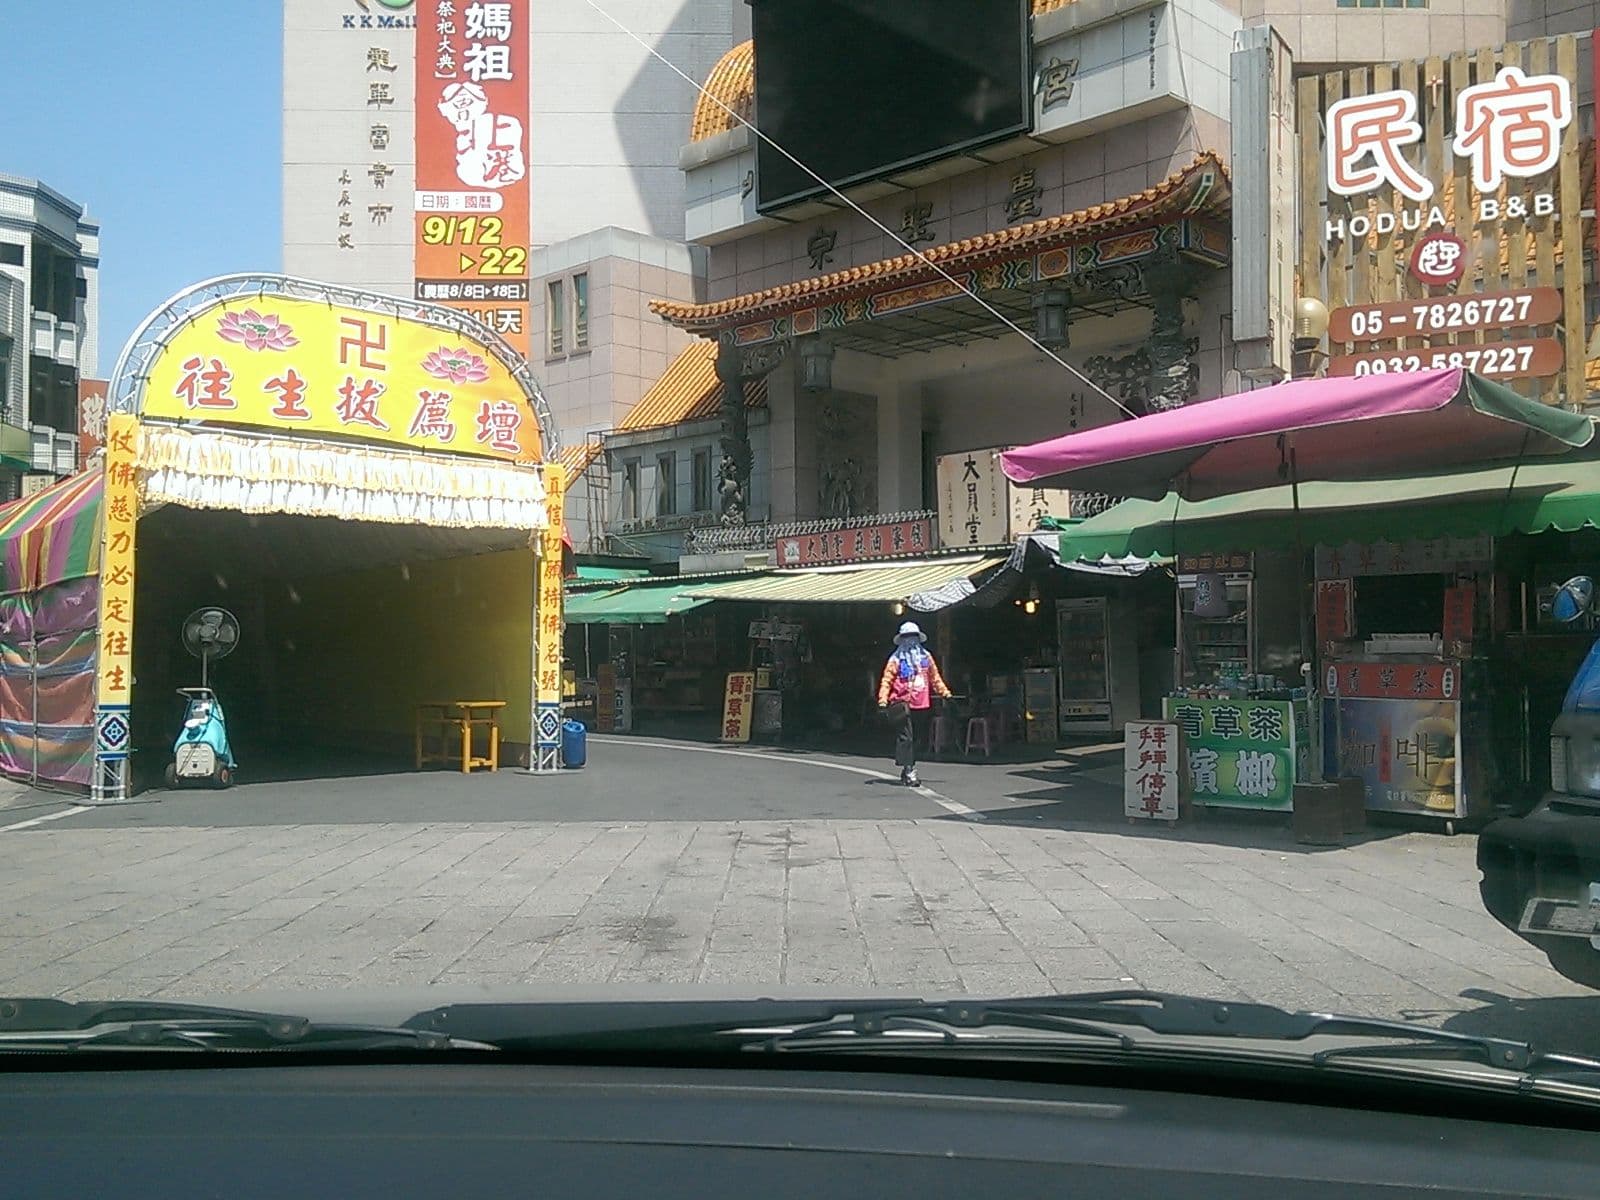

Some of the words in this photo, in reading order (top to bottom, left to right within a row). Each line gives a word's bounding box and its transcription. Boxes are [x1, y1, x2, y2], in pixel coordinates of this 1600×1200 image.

[463, 1, 514, 81] 媽祖
[1041, 57, 1079, 110] 宮
[1326, 67, 1572, 201] 民宿
[422, 215, 503, 246] 9/12
[1325, 206, 1446, 241] HODUA
[1480, 193, 1555, 223] B&B
[478, 246, 527, 276] 22
[175, 356, 521, 452] 往生拔薦壇
[103, 428, 136, 693] 仗佛慈力必定往生
[541, 475, 563, 692] 真信切願持佛名號
[1345, 666, 1436, 694] 青草茶
[1174, 703, 1283, 742] 青草茶
